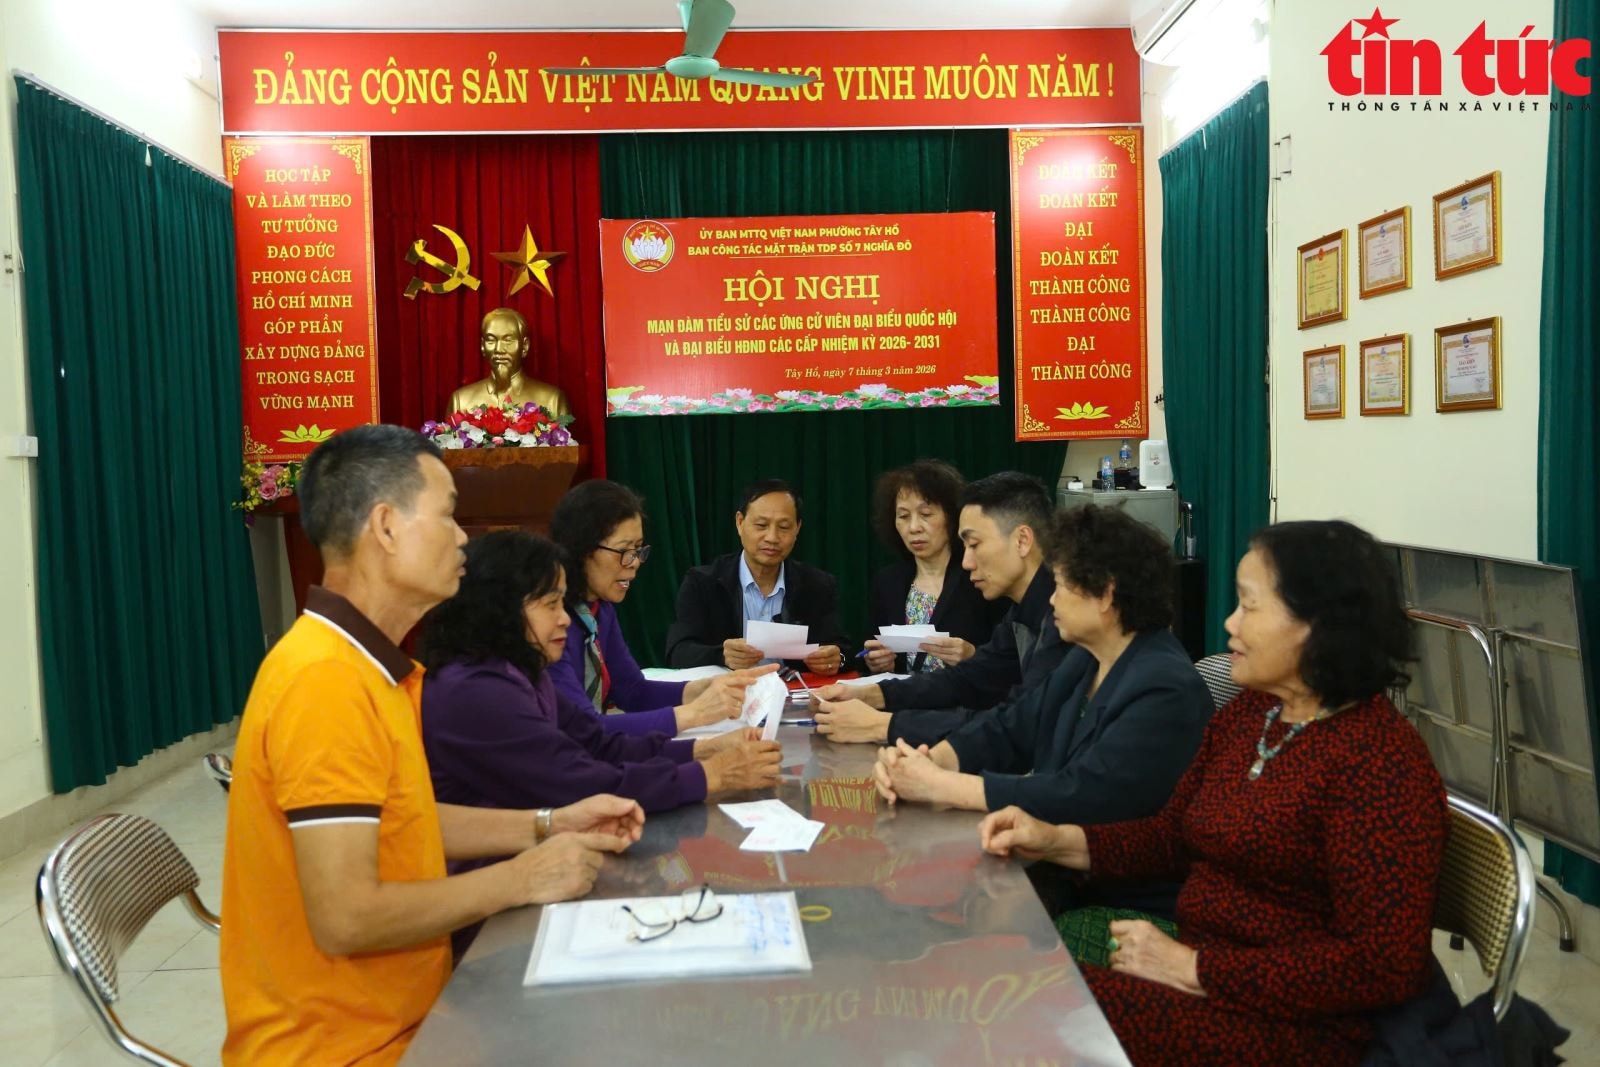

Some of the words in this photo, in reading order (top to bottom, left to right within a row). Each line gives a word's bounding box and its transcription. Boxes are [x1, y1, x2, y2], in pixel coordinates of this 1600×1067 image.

[253, 51, 352, 106] ĐẢNG
[361, 57, 453, 114] CỘNG
[462, 51, 528, 104] SẢN
[538, 57, 615, 112] VIỆT
[625, 70, 700, 103] NAM
[709, 67, 824, 104] QUANG
[833, 66, 916, 100] VINH
[924, 53, 1018, 100] MUÔN
[1028, 51, 1100, 98] NĂM
[265, 167, 300, 185] HỌC
[298, 163, 331, 184] TẬP
[1088, 156, 1118, 179] KẾT
[246, 192, 269, 208] VÀ
[272, 192, 306, 207] LÀM
[309, 194, 351, 207] THEO
[1087, 184, 1118, 208] KẾT
[262, 218, 283, 233] TƯ
[285, 213, 338, 232] TƯỞNG
[700, 227, 713, 239] ỦY
[716, 230, 737, 239] BAN
[740, 229, 768, 240] MTTQ
[770, 227, 791, 240] VIỆT
[794, 229, 817, 237] NAM
[863, 225, 882, 235] TÂY
[1064, 221, 1093, 241] ĐẠI
[268, 245, 300, 261] ĐẠO
[304, 241, 334, 257] ĐỨC
[688, 246, 709, 255] BAN
[712, 244, 740, 255] CÔNG
[742, 243, 762, 254] TÁC
[765, 243, 787, 257] MẶT
[788, 242, 815, 255] TRẬN
[817, 244, 837, 252] TDP
[839, 240, 853, 252] SỐ
[855, 243, 861, 251] 7
[864, 240, 895, 251] NGHĨA
[1041, 247, 1084, 266] ĐOÀN
[1088, 243, 1118, 264] KẾT
[252, 270, 307, 283] PHONG
[310, 266, 352, 283] CÁCH
[1030, 276, 1084, 295] THÀNH
[1088, 274, 1130, 293] CÔNG
[724, 270, 784, 307] HỘI
[795, 275, 880, 305] NGHỊ
[253, 290, 275, 309] HỒ
[279, 292, 306, 308] CHÍ
[310, 295, 352, 308] MINH
[648, 320, 674, 336] MẠN
[707, 313, 731, 332] TIỂU
[735, 313, 751, 331] SỬ
[754, 315, 776, 330] CÁC
[780, 314, 803, 330] ỨNG
[807, 312, 823, 329] CỬ
[825, 313, 850, 328] VIÊN
[854, 315, 872, 330] ĐẠI
[876, 309, 901, 327] BIỂU
[905, 308, 934, 328] QUỐC
[938, 309, 956, 328] HỘI
[1030, 304, 1085, 323] THÀNH
[1089, 303, 1131, 322] CÔNG
[264, 317, 295, 334] GÓP
[300, 314, 343, 333] PHẦN
[246, 343, 275, 359] XÂY
[280, 344, 320, 362] DỰNG
[324, 340, 365, 358] ĐẢNG
[665, 340, 680, 355] VÀ
[683, 342, 702, 358] ĐẠI
[705, 336, 731, 354] BIỂU
[735, 340, 766, 353] HĐND
[770, 337, 792, 352] CÁC
[796, 334, 818, 352] CẤP
[822, 335, 858, 353] NHIỆM
[862, 334, 876, 350] KỲ
[914, 335, 939, 348] 2031
[1067, 336, 1095, 354] ĐẠI
[257, 371, 311, 384] TRONG
[314, 370, 354, 386] SẠCH
[785, 369, 802, 379] Tây
[849, 367, 854, 376] 7
[885, 366, 891, 375] 3
[915, 365, 936, 373] 2026
[1031, 361, 1086, 380] THÀNH
[1090, 360, 1131, 379] CÔNG
[260, 394, 303, 409] VỮNG
[307, 395, 354, 411] MẠNH
